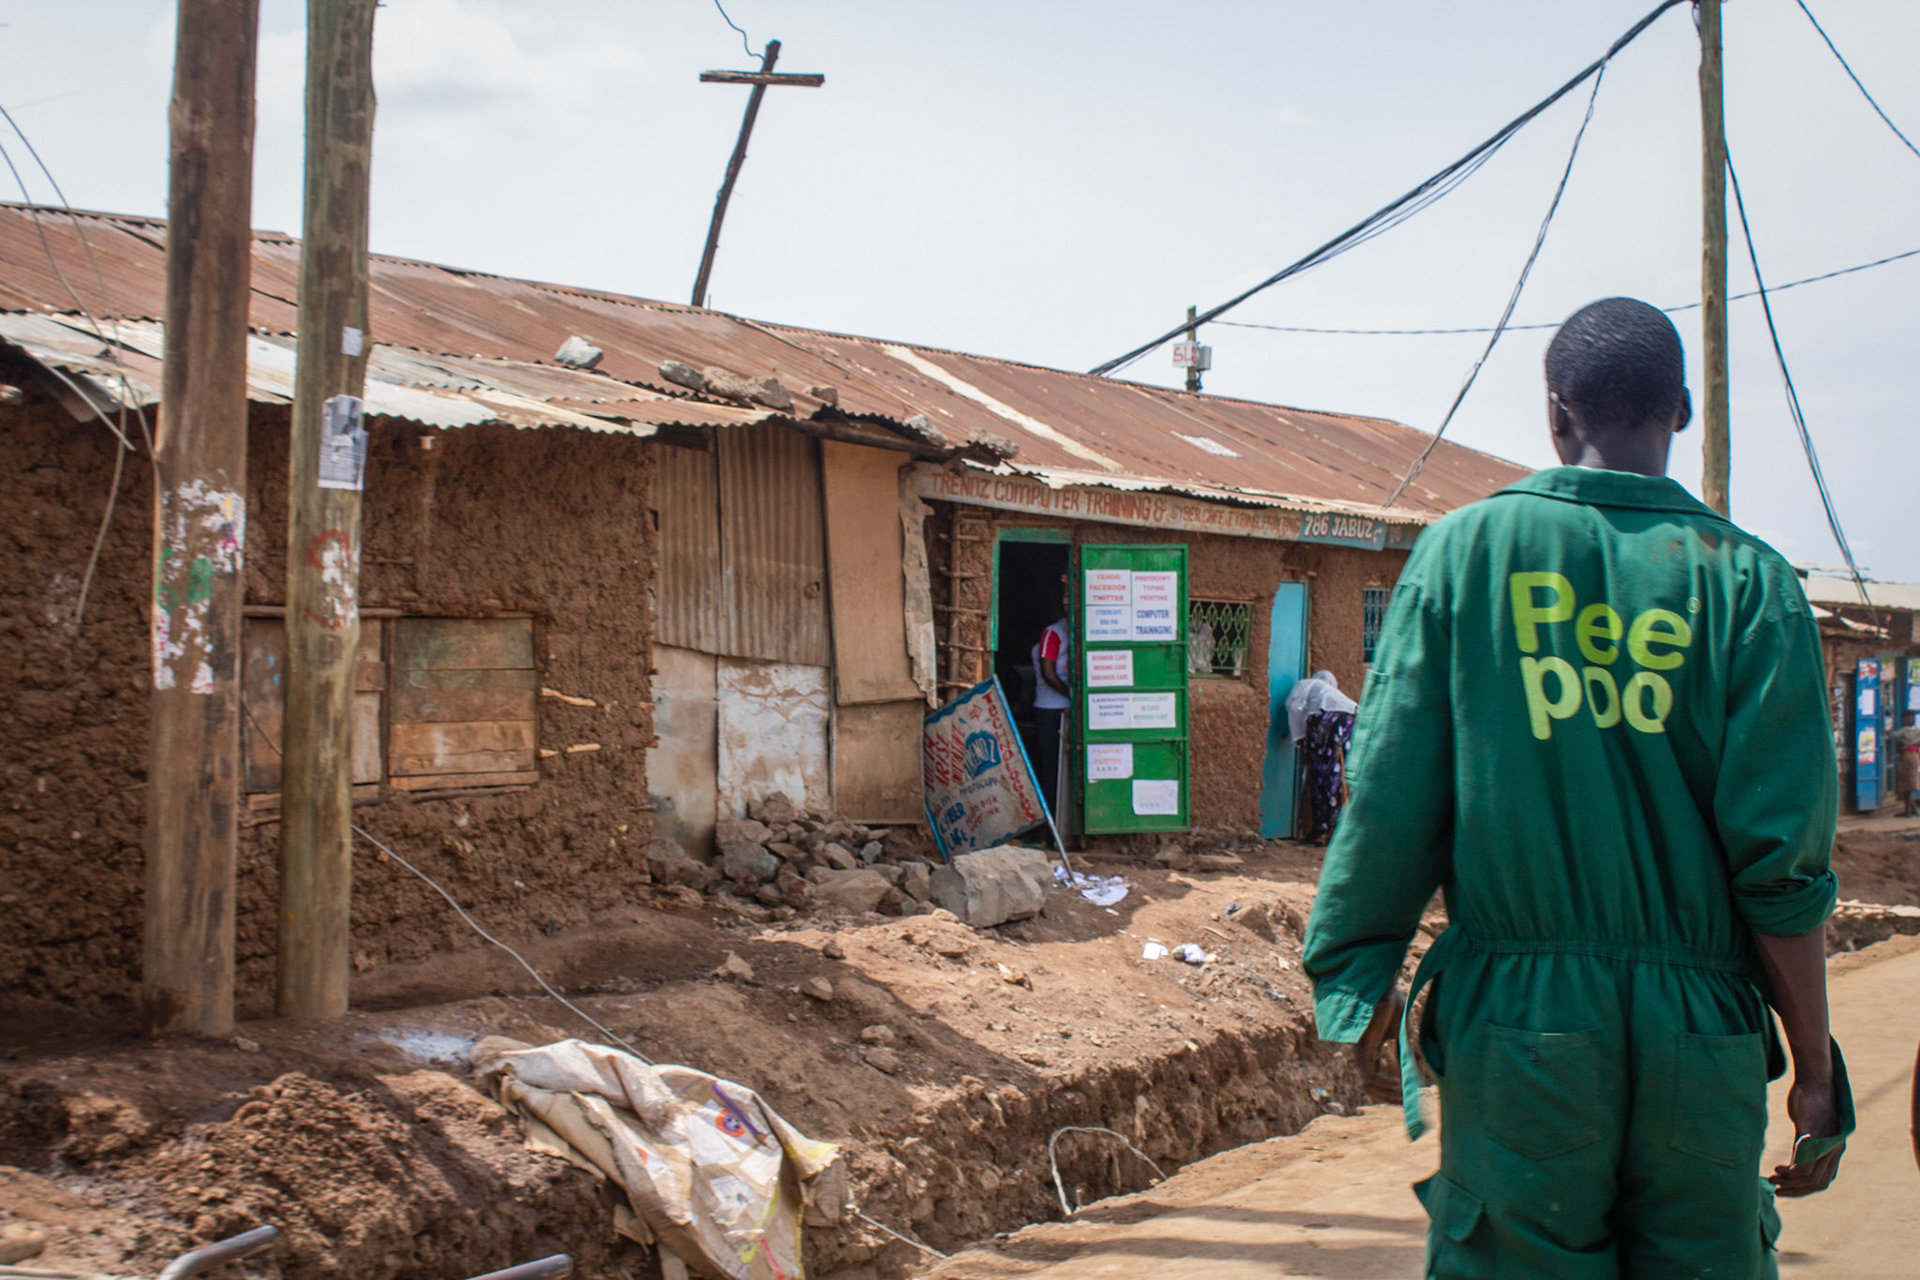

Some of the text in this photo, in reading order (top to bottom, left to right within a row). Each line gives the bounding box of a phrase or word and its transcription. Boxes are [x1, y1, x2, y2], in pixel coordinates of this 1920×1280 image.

[931, 472, 990, 499] TRENDZ
[994, 480, 1080, 511] COMPUTER
[1084, 490, 1152, 521] TRAINING
[1153, 497, 1167, 522] &
[1304, 515, 1330, 539] 786
[1331, 517, 1374, 541] JABUZ
[1136, 609, 1169, 619] COMPUTER
[1509, 572, 1692, 669] Pee
[1519, 656, 1673, 740] poo
